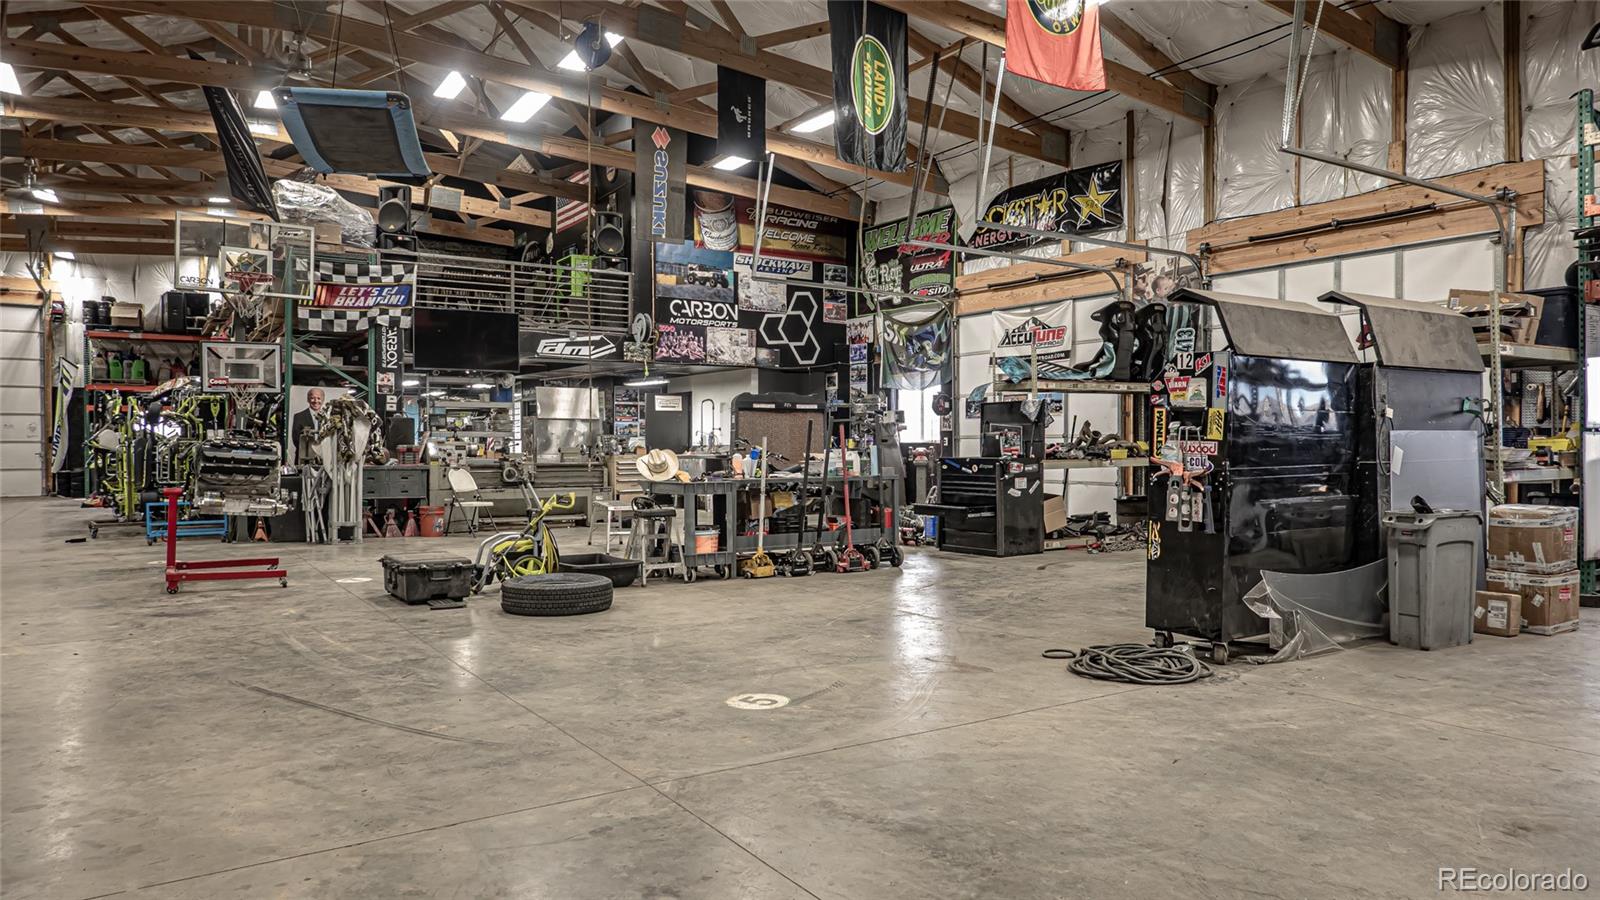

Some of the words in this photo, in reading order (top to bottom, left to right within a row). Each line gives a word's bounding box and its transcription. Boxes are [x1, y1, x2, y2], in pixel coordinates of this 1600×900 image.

[864, 60, 872, 118] ROVER
[874, 60, 886, 107] LAND
[765, 214, 819, 229] RACING
[766, 207, 838, 223] BUDWEISER
[179, 275, 214, 285] CARBON
[340, 286, 381, 296] LET'S
[669, 299, 739, 320] CARBON
[669, 317, 738, 328] MOTORSPORTS
[1180, 353, 1193, 368] 12
[1156, 410, 1164, 456] PAINLESS
[738, 696, 778, 706] 5
